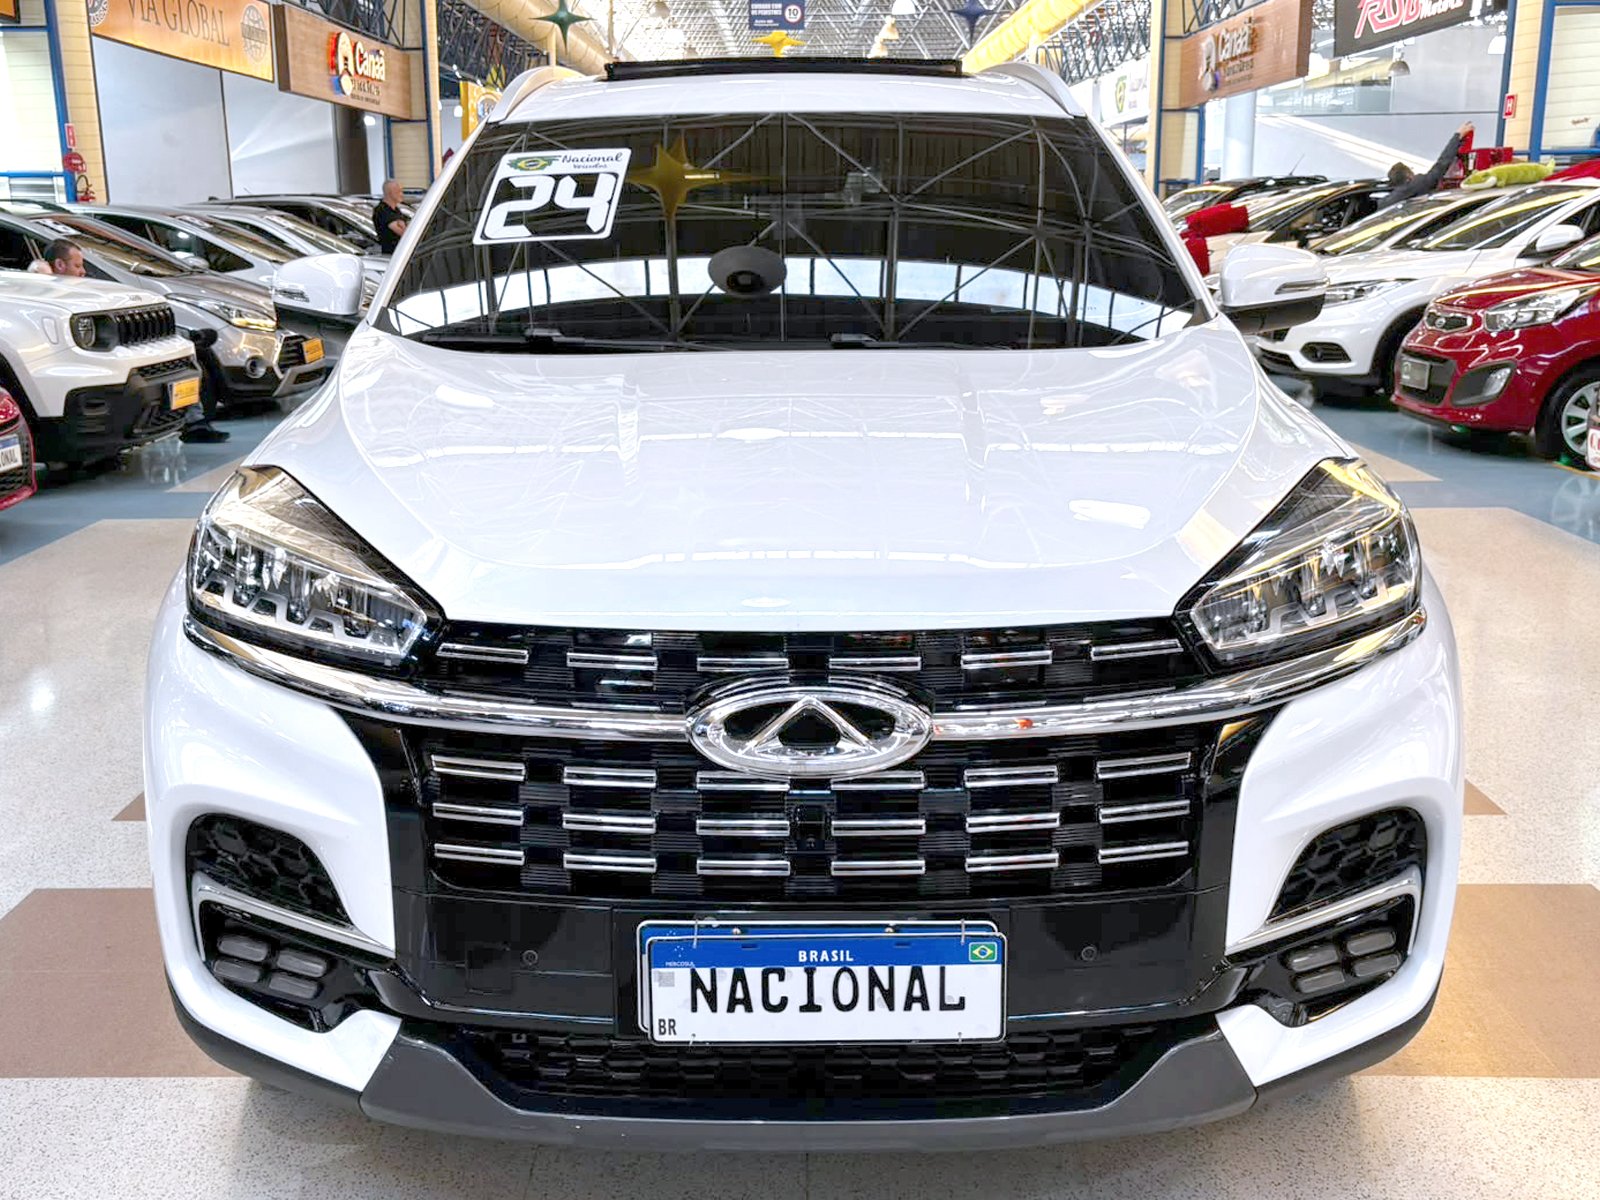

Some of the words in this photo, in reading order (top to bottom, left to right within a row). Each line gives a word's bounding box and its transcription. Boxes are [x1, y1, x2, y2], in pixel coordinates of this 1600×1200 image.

[788, 8, 798, 16] 10
[163, 0, 230, 46] GLOBAL
[561, 152, 623, 164] Nacional
[484, 172, 617, 239] 24
[798, 949, 854, 962] BRASIL
[690, 966, 966, 1013] NACIONAL
[658, 1018, 677, 1036] BR
